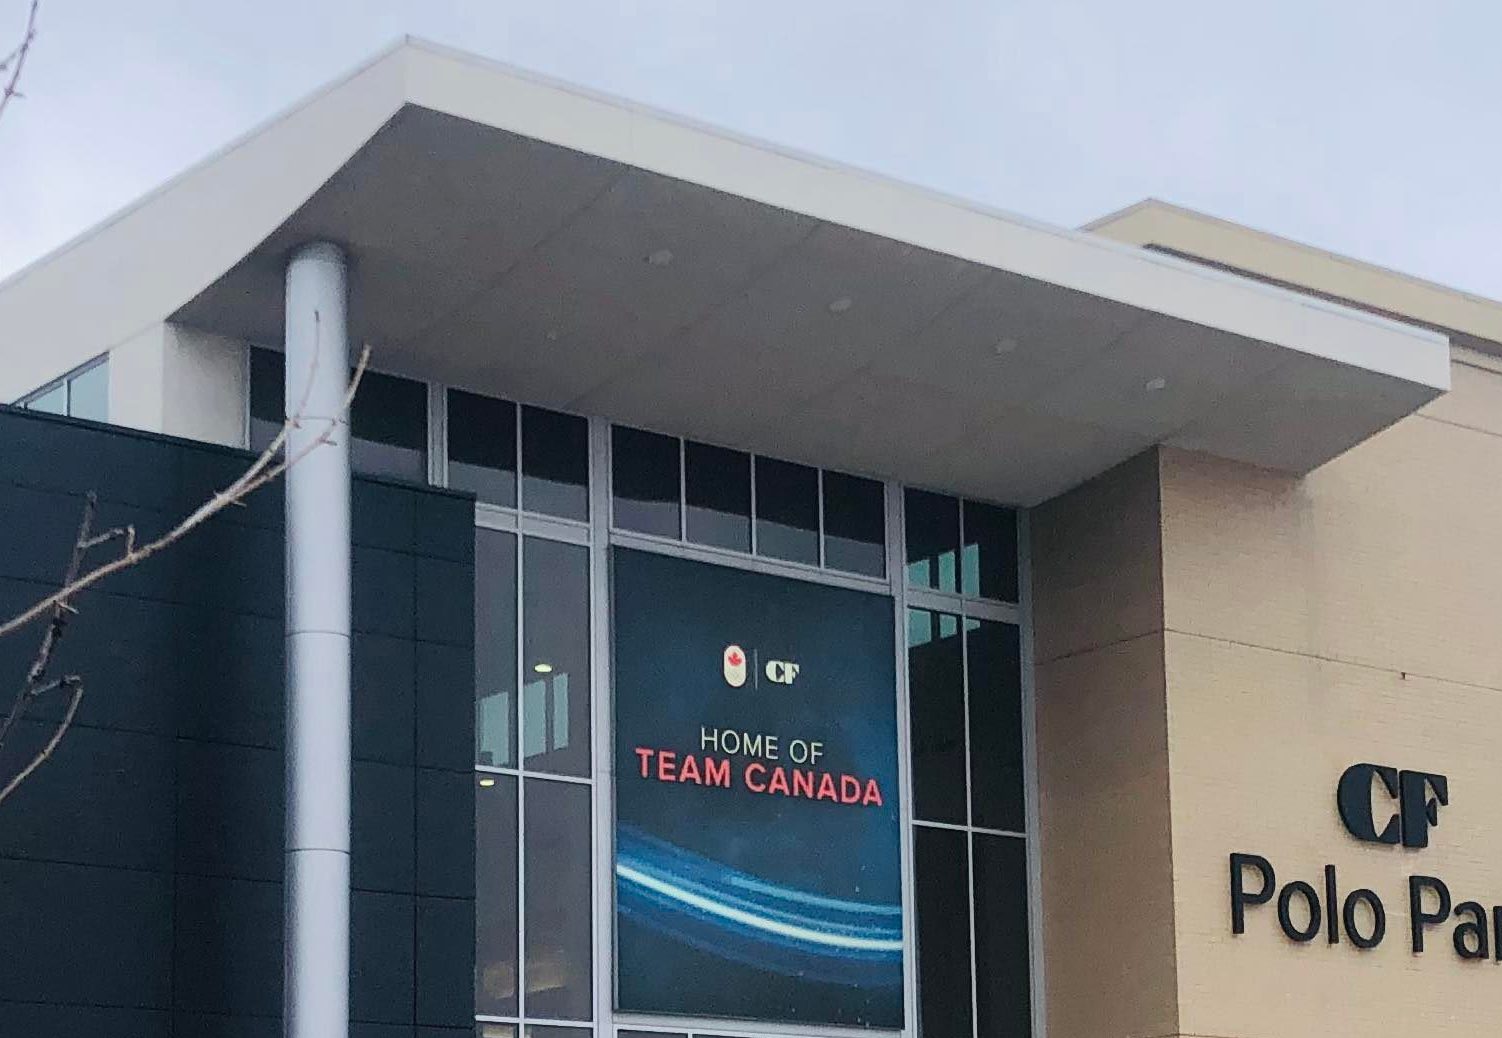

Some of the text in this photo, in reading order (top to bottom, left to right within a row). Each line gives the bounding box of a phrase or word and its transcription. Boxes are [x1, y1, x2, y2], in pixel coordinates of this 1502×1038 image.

[765, 660, 800, 685] CF
[701, 726, 823, 765] HOME OF
[635, 747, 884, 806] TEAM CANADA
[1337, 763, 1449, 848] CF
[1229, 852, 1386, 949] Polo
